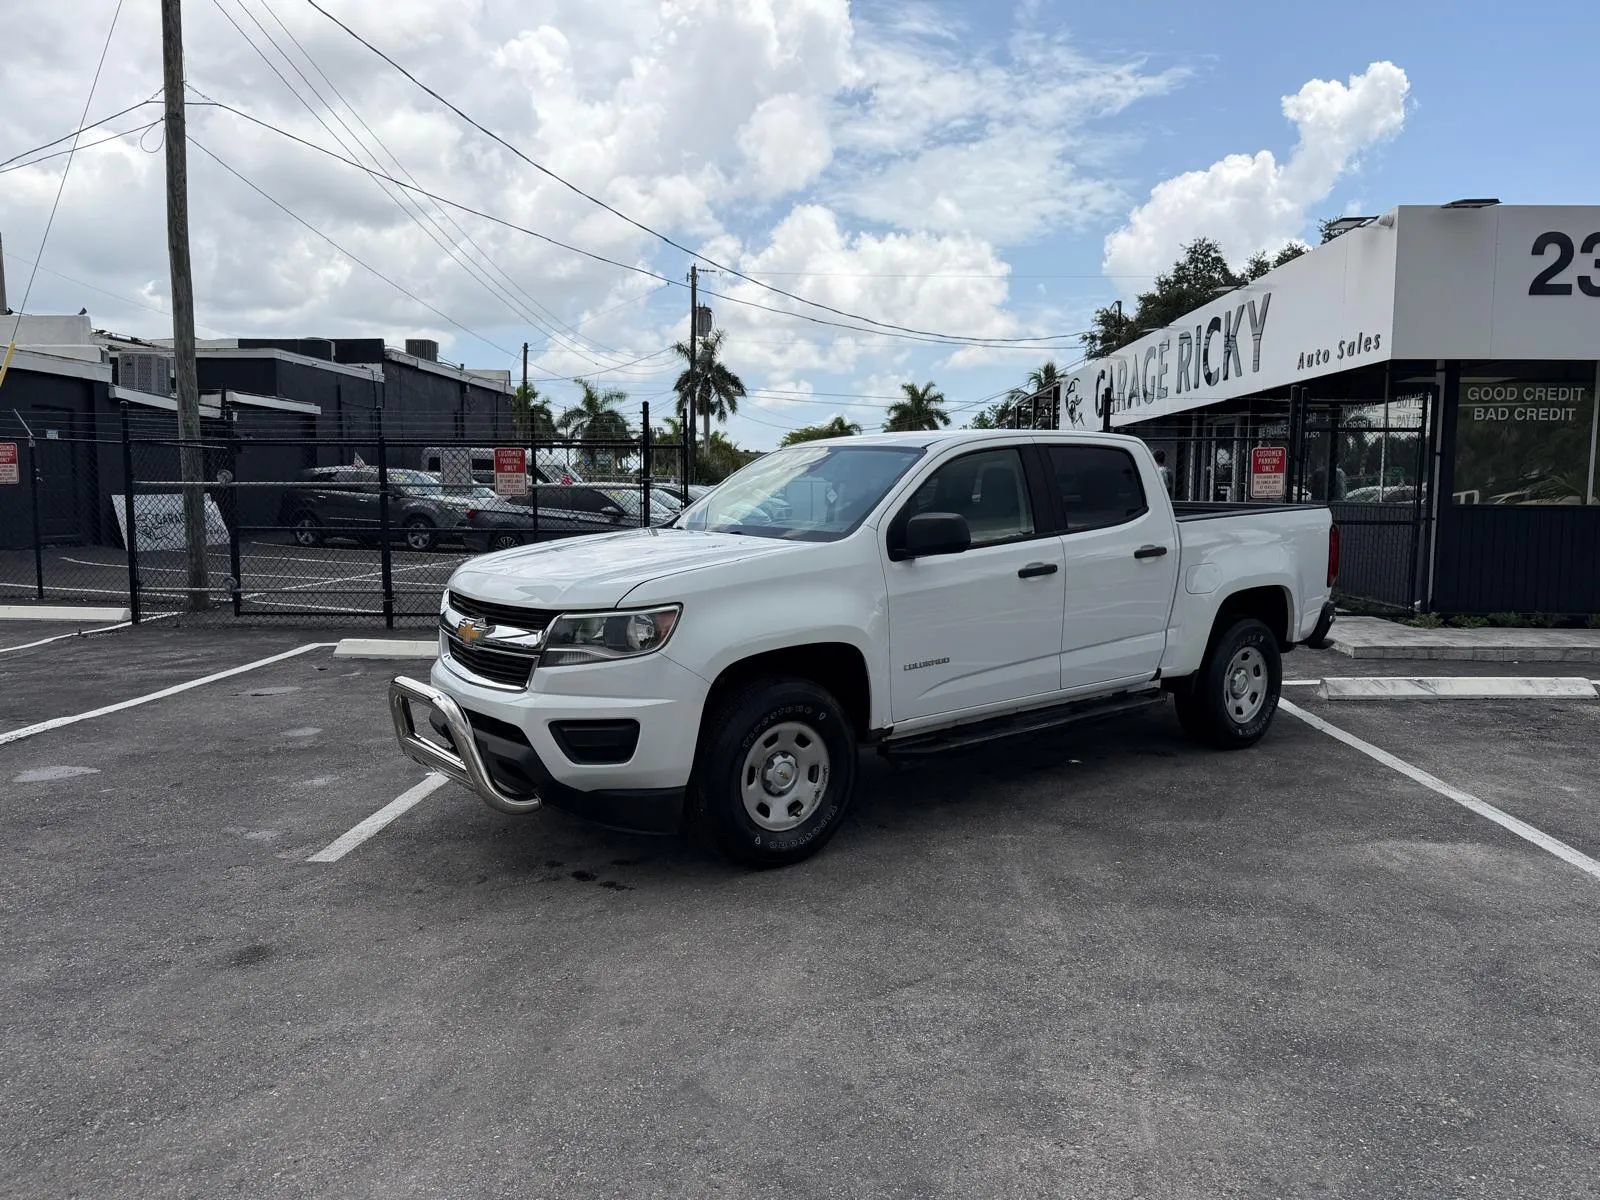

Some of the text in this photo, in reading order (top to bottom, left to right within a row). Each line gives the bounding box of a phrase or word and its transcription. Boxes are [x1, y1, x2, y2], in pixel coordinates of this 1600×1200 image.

[1095, 292, 1271, 418] GARAGE RICKY
[1297, 332, 1381, 370] Auto Sales
[1467, 387, 1585, 401] GOOD CREDIT
[1473, 408, 1576, 420] BAD CREDIT
[1258, 457, 1280, 465] PARKING
